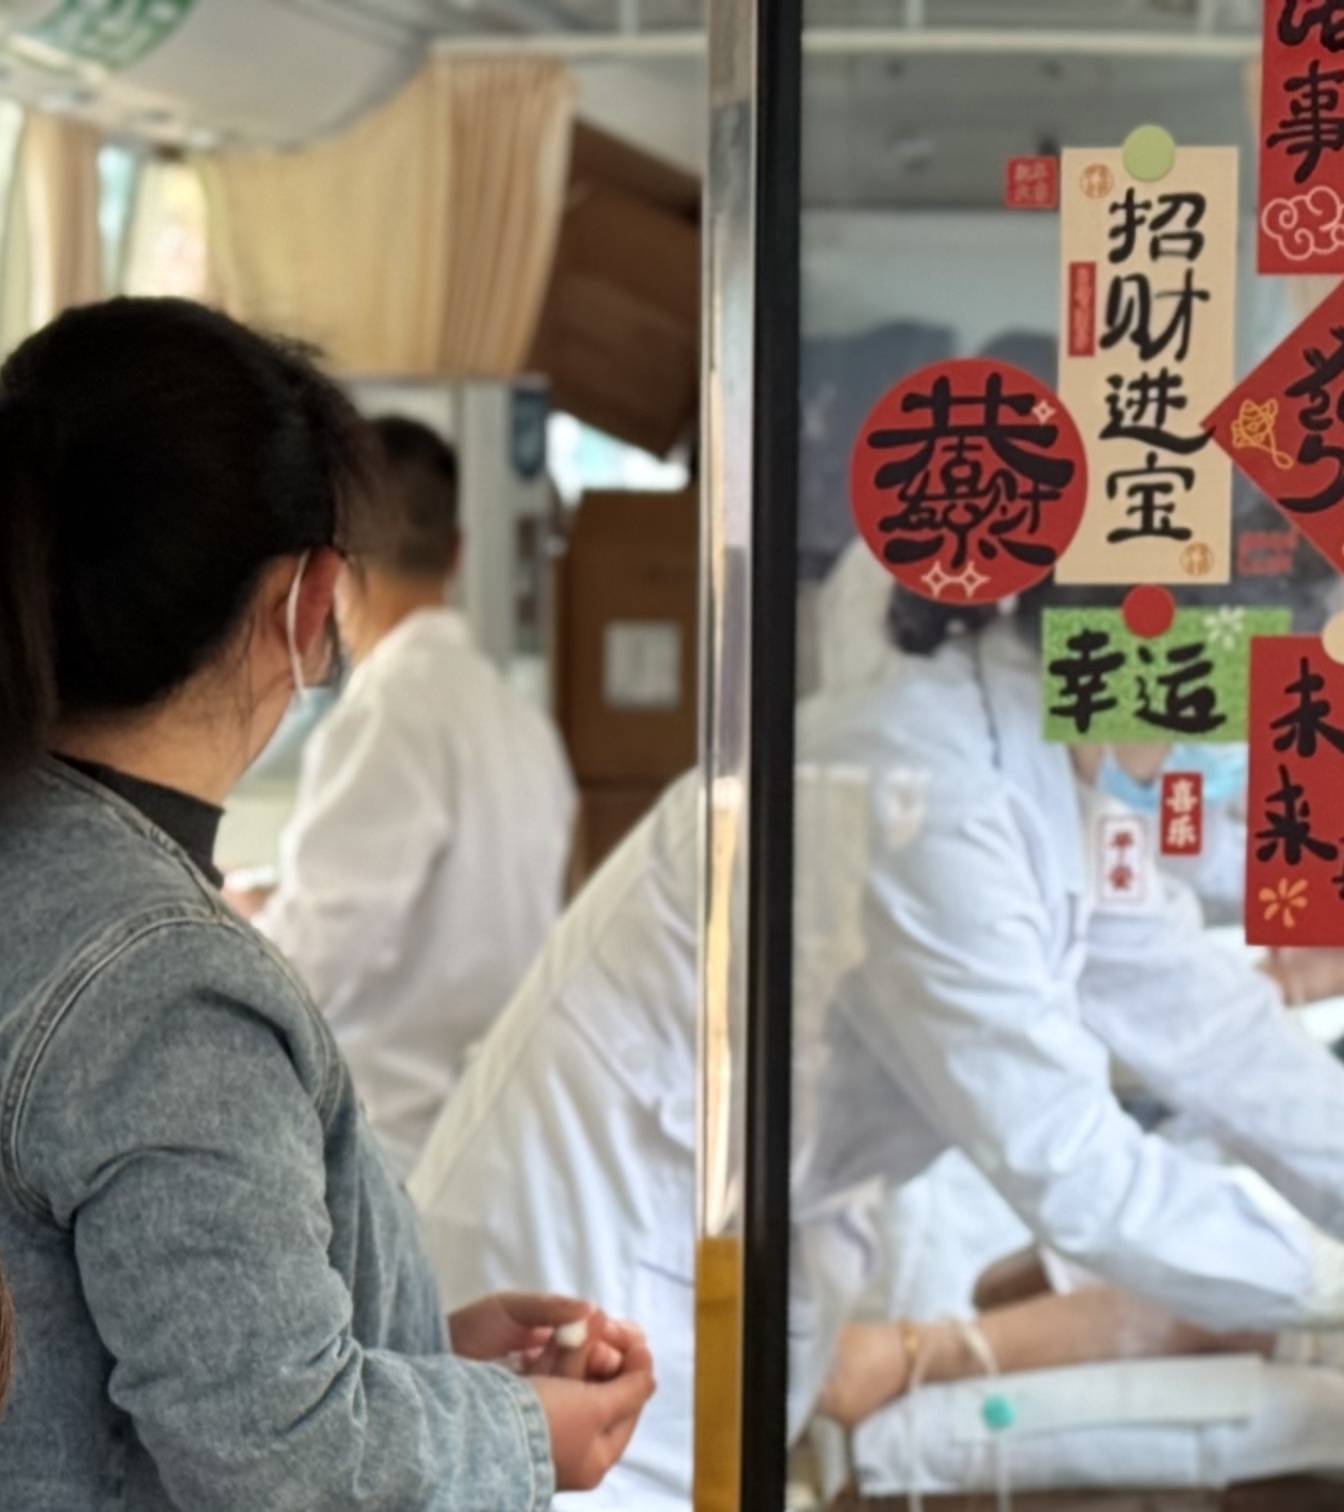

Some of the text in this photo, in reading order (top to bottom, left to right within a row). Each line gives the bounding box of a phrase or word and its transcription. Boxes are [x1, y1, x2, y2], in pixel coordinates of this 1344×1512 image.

[1098, 187, 1216, 544] 招财进宝
[1048, 628, 1227, 734] 幸运
[1166, 777, 1197, 848] 喜乐
